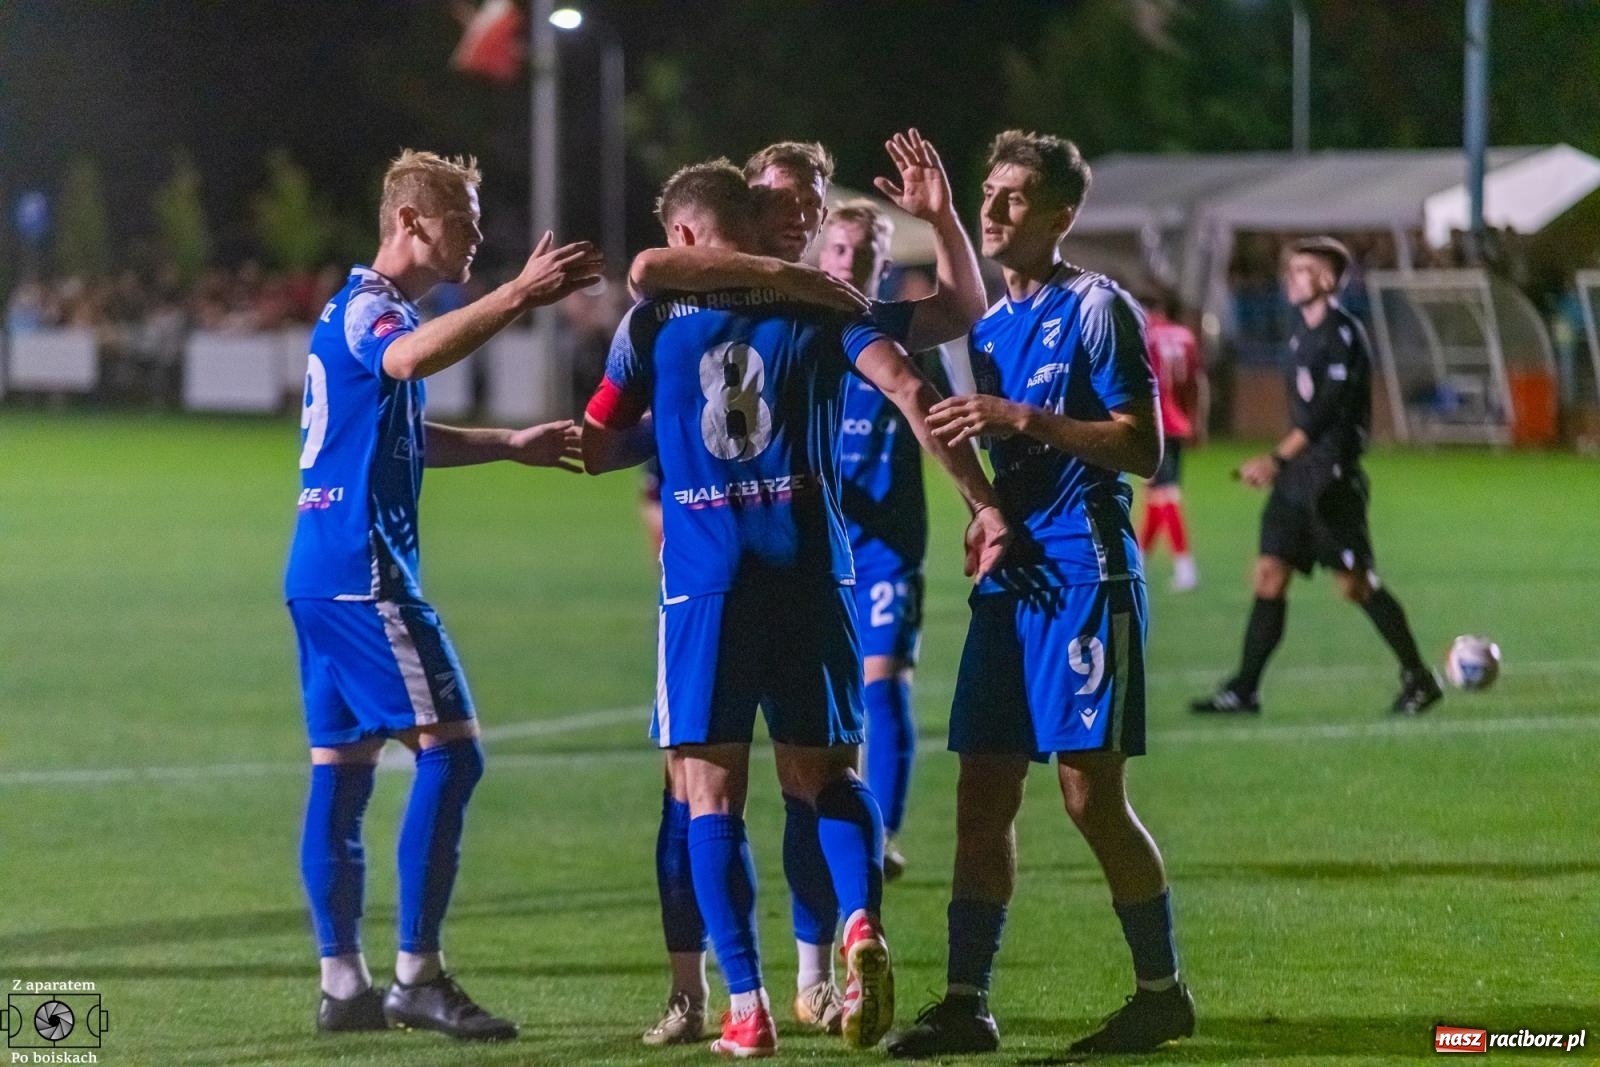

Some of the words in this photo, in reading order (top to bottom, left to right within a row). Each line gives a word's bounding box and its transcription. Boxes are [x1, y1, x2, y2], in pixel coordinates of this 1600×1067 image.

[655, 294, 700, 322] UNIA
[698, 341, 772, 462] 8
[1067, 634, 1105, 696] 9
